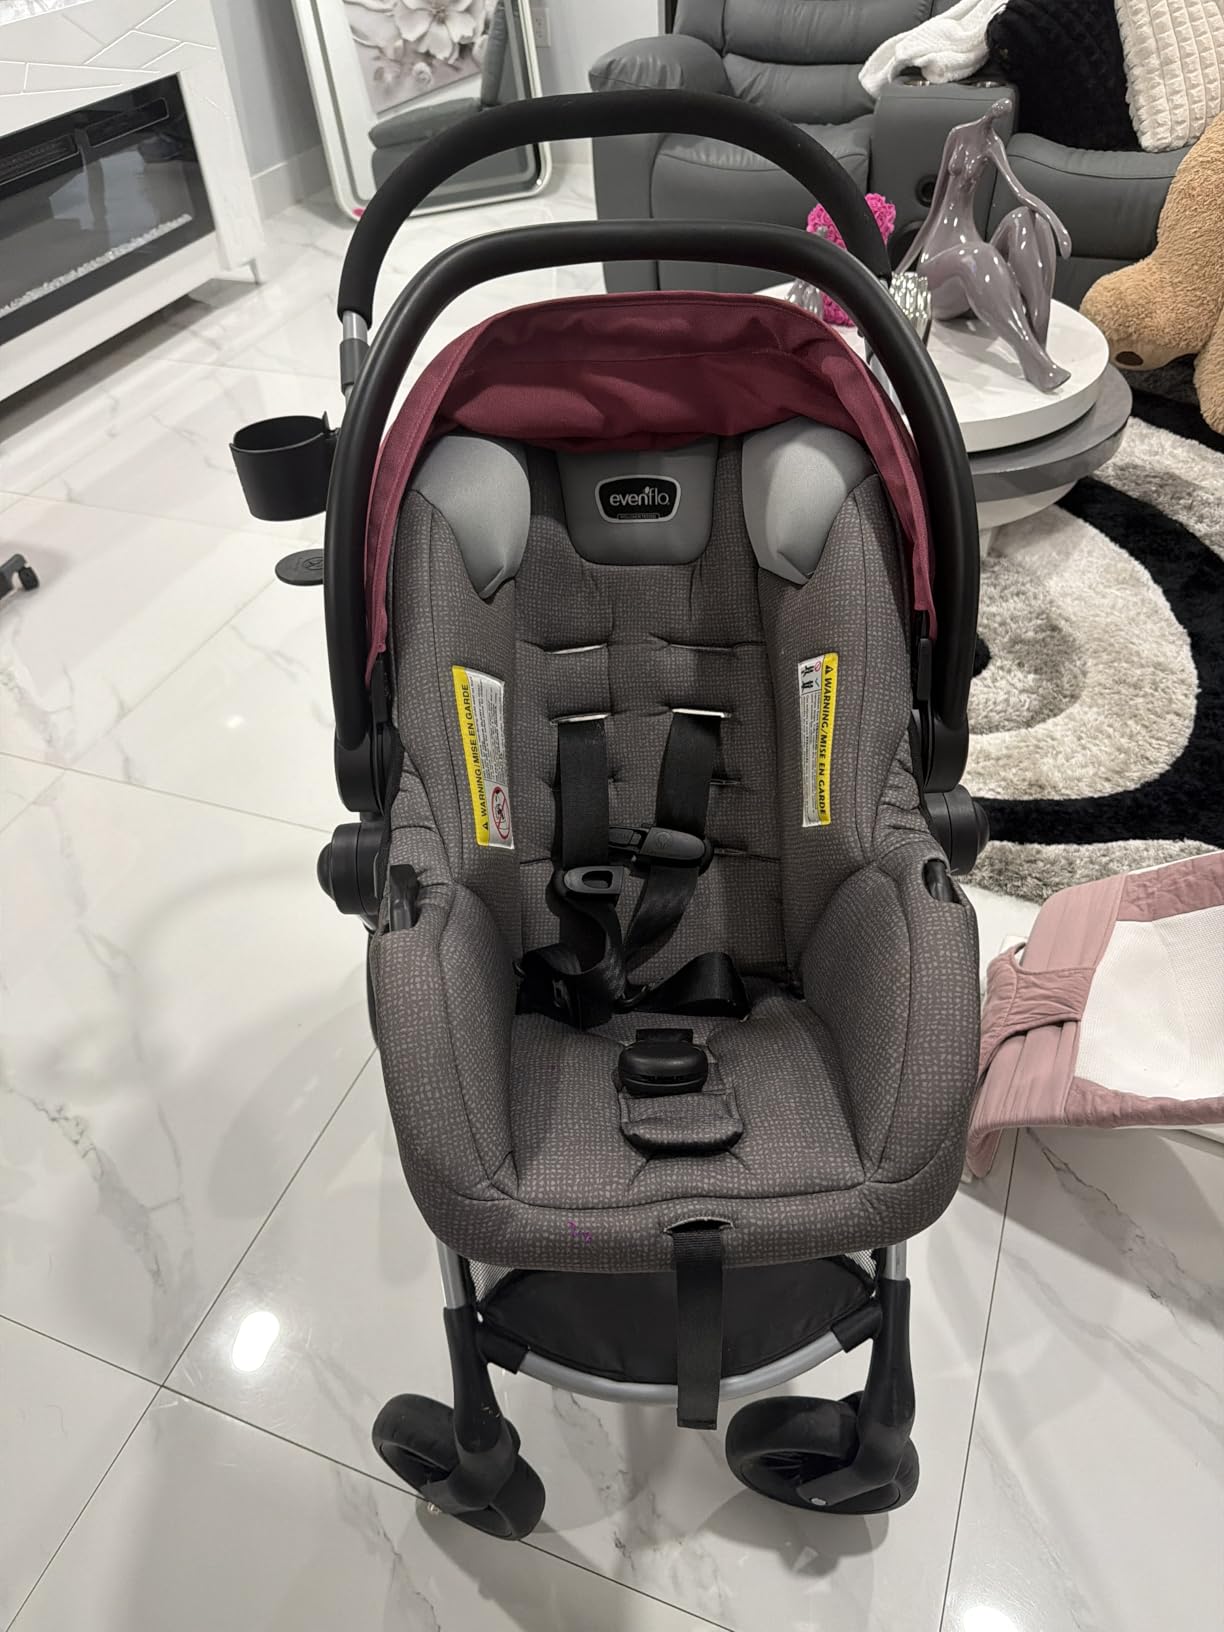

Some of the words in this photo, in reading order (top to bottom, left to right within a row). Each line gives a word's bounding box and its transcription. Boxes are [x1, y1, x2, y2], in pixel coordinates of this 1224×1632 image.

[609, 486, 668, 506] evenflo
[462, 684, 473, 720] GARDE
[467, 722, 476, 736] EN
[819, 762, 826, 776] EN
[818, 779, 826, 814] GARDE
